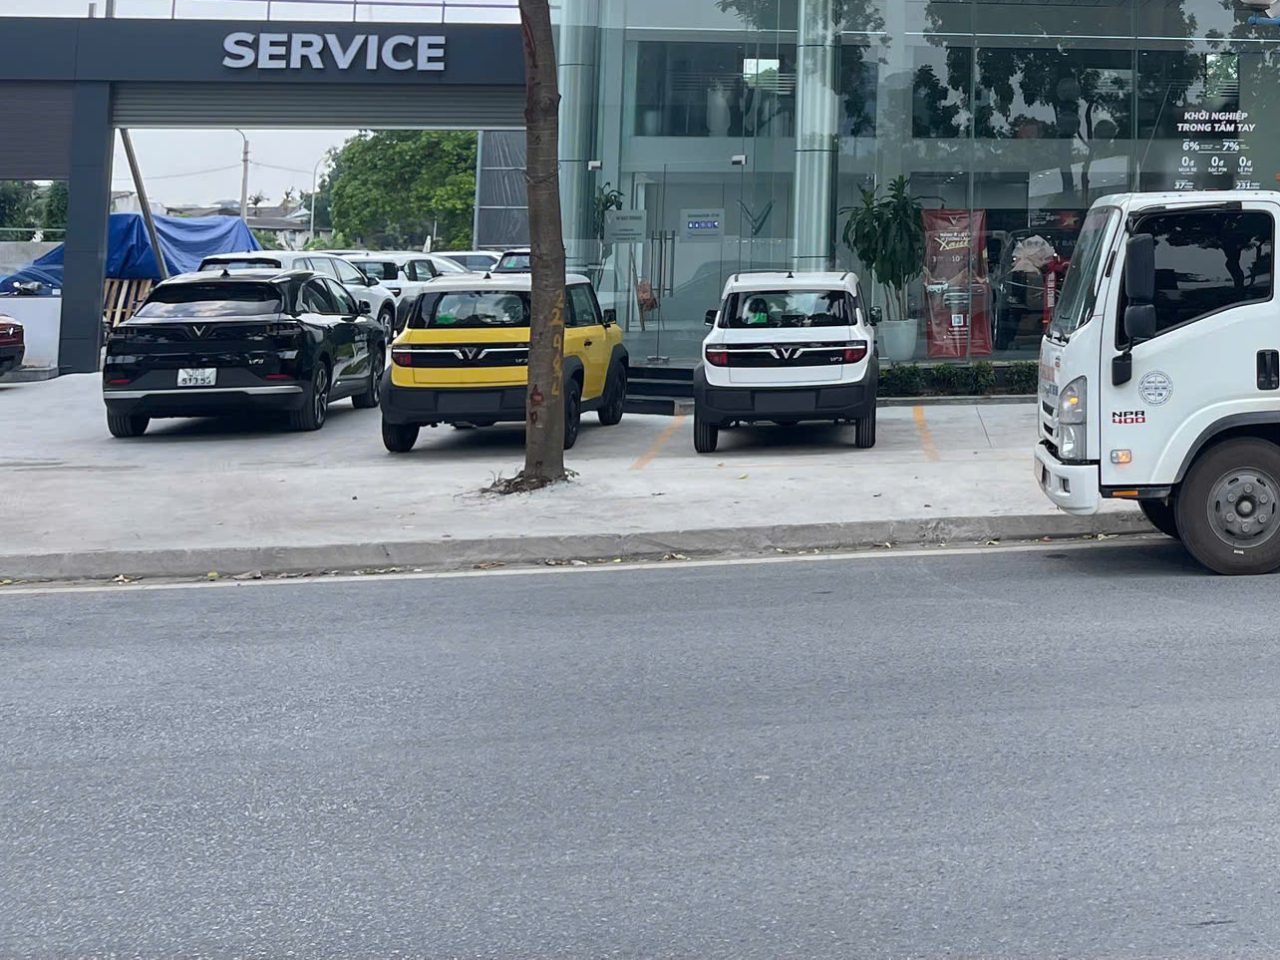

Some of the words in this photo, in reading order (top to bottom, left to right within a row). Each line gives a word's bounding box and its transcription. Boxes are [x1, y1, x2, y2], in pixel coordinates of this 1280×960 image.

[222, 32, 446, 71] SERVICE
[1184, 110, 1209, 120] KHỞI
[1211, 110, 1248, 122] NGHIỆP
[1177, 123, 1211, 132] TRONG
[1236, 124, 1255, 132] TAY
[1182, 142, 1200, 151] 6%
[1222, 142, 1240, 151] 7%
[1112, 410, 1145, 418] NPR
